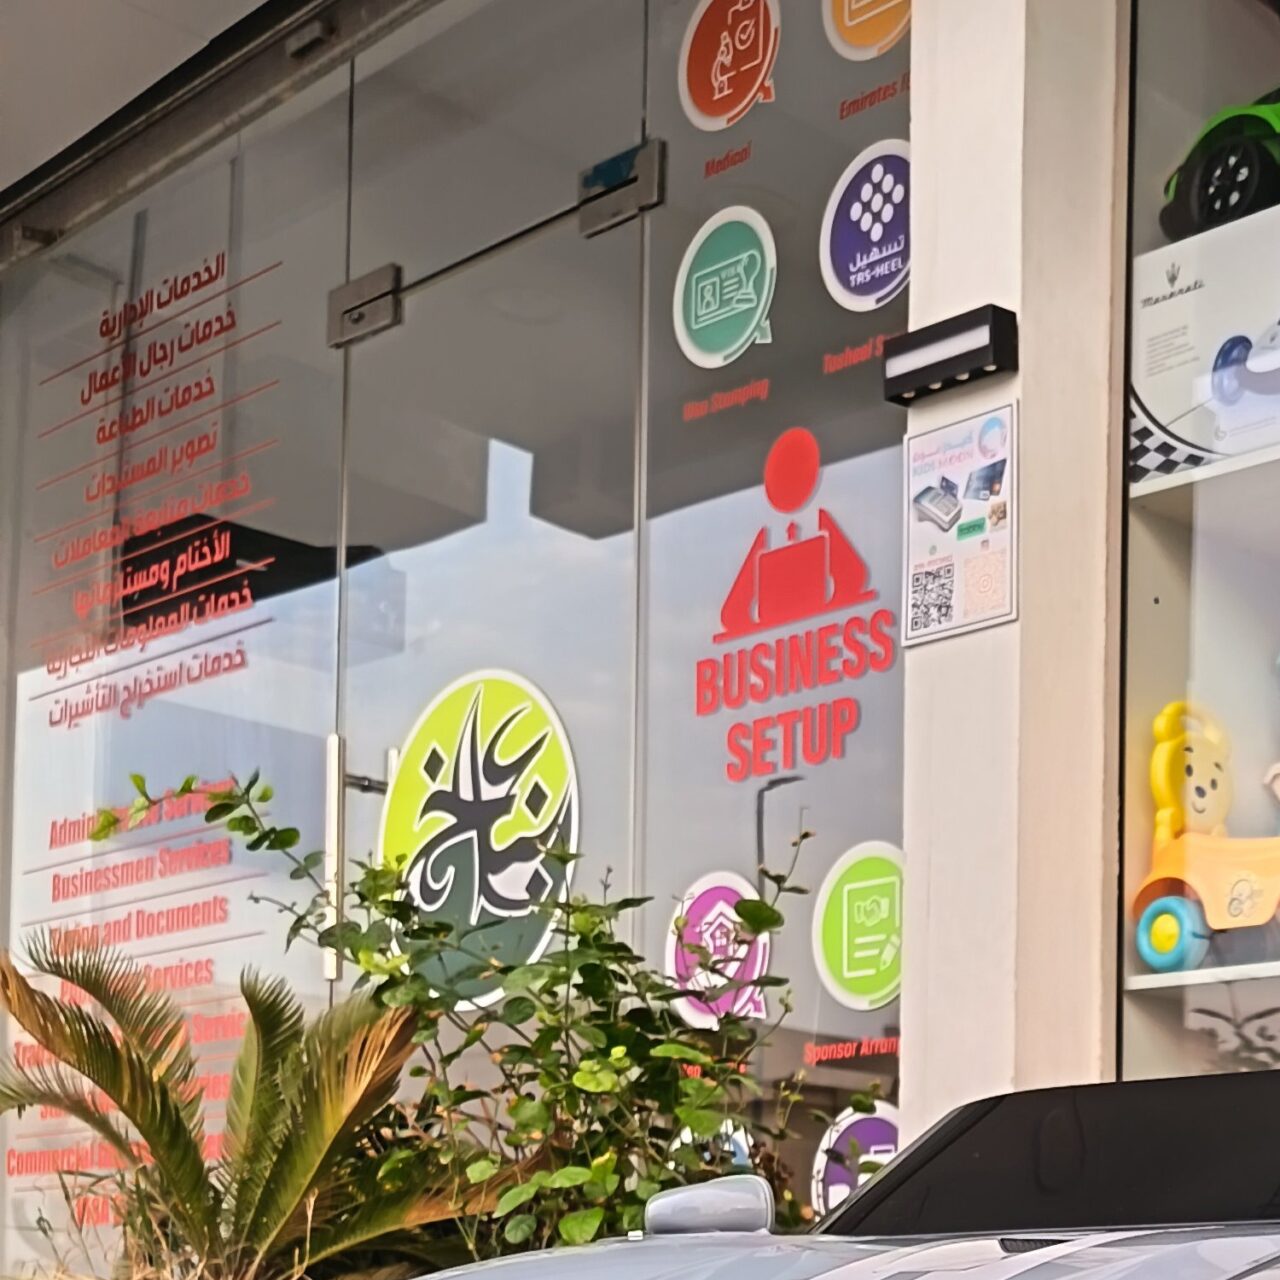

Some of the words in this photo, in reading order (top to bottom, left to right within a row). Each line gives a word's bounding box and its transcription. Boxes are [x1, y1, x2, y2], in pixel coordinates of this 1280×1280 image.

[849, 234, 905, 272] تسهيل
[849, 257, 905, 288] TAS-HEEL
[156, 252, 226, 310] الخدمات
[177, 301, 237, 353] خدمات
[139, 338, 175, 378] رجال
[157, 368, 215, 417] خدمات
[171, 421, 218, 476] تصوير
[172, 529, 231, 592] الأختام
[193, 579, 254, 625] خدمات
[187, 639, 248, 685] خدمات
[695, 608, 896, 717] BUSINESS
[725, 697, 859, 783] SETUP
[51, 855, 155, 904] Businessmen
[103, 911, 132, 947] and
[135, 895, 229, 940] Documents
[804, 1040, 858, 1067] Sponsor
